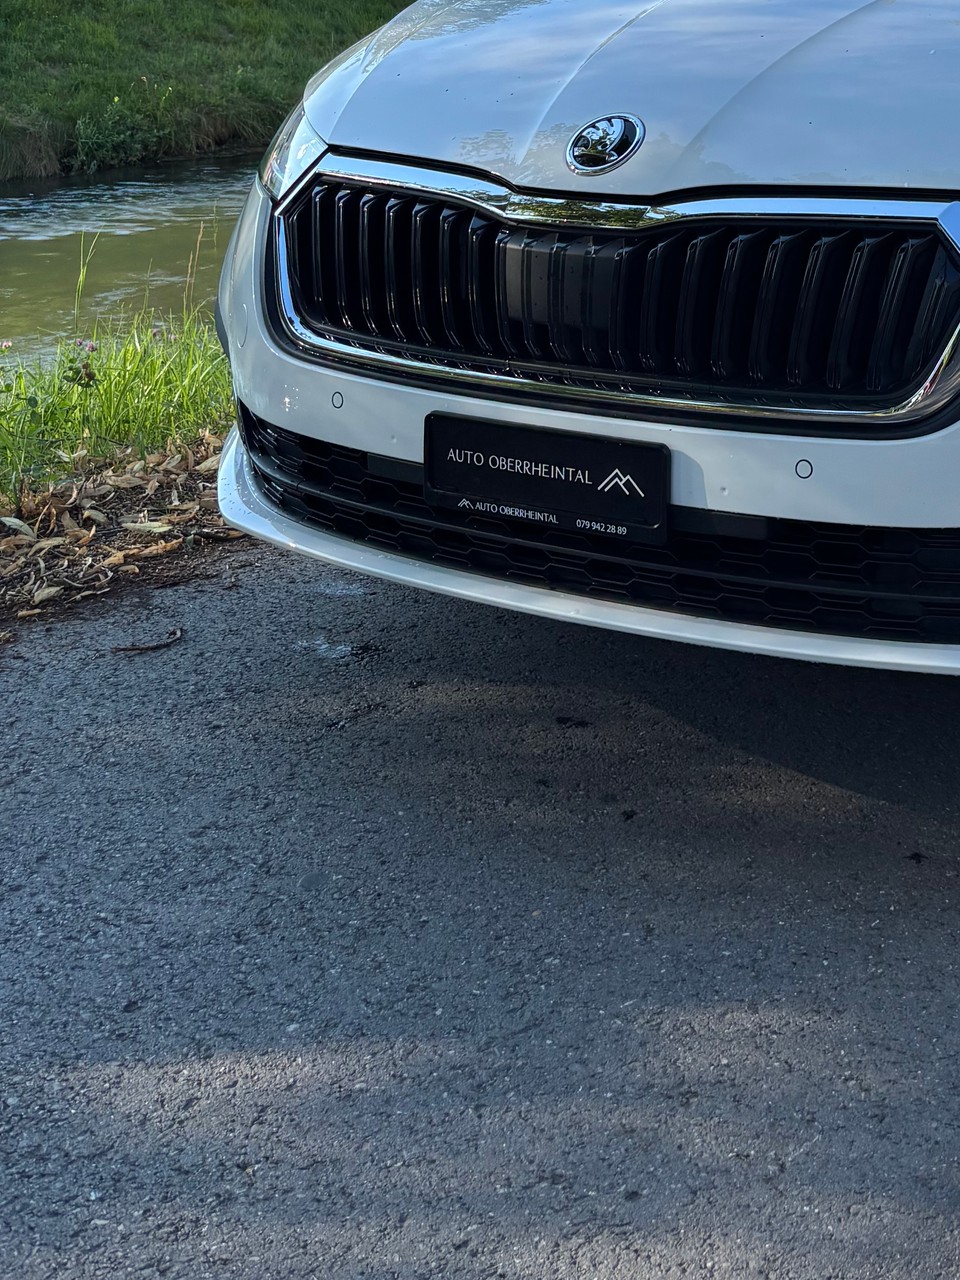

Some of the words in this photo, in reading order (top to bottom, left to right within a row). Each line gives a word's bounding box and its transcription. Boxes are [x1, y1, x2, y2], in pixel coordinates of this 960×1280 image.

[447, 448, 484, 466] AUTO
[488, 454, 593, 485] OBERRHEINTAL
[475, 502, 498, 513] AUTO
[499, 505, 559, 524] OBERRHEINTAL
[576, 519, 590, 529] 079
[591, 521, 605, 532] 942
[606, 524, 616, 534] 28
[617, 526, 627, 535] 89
